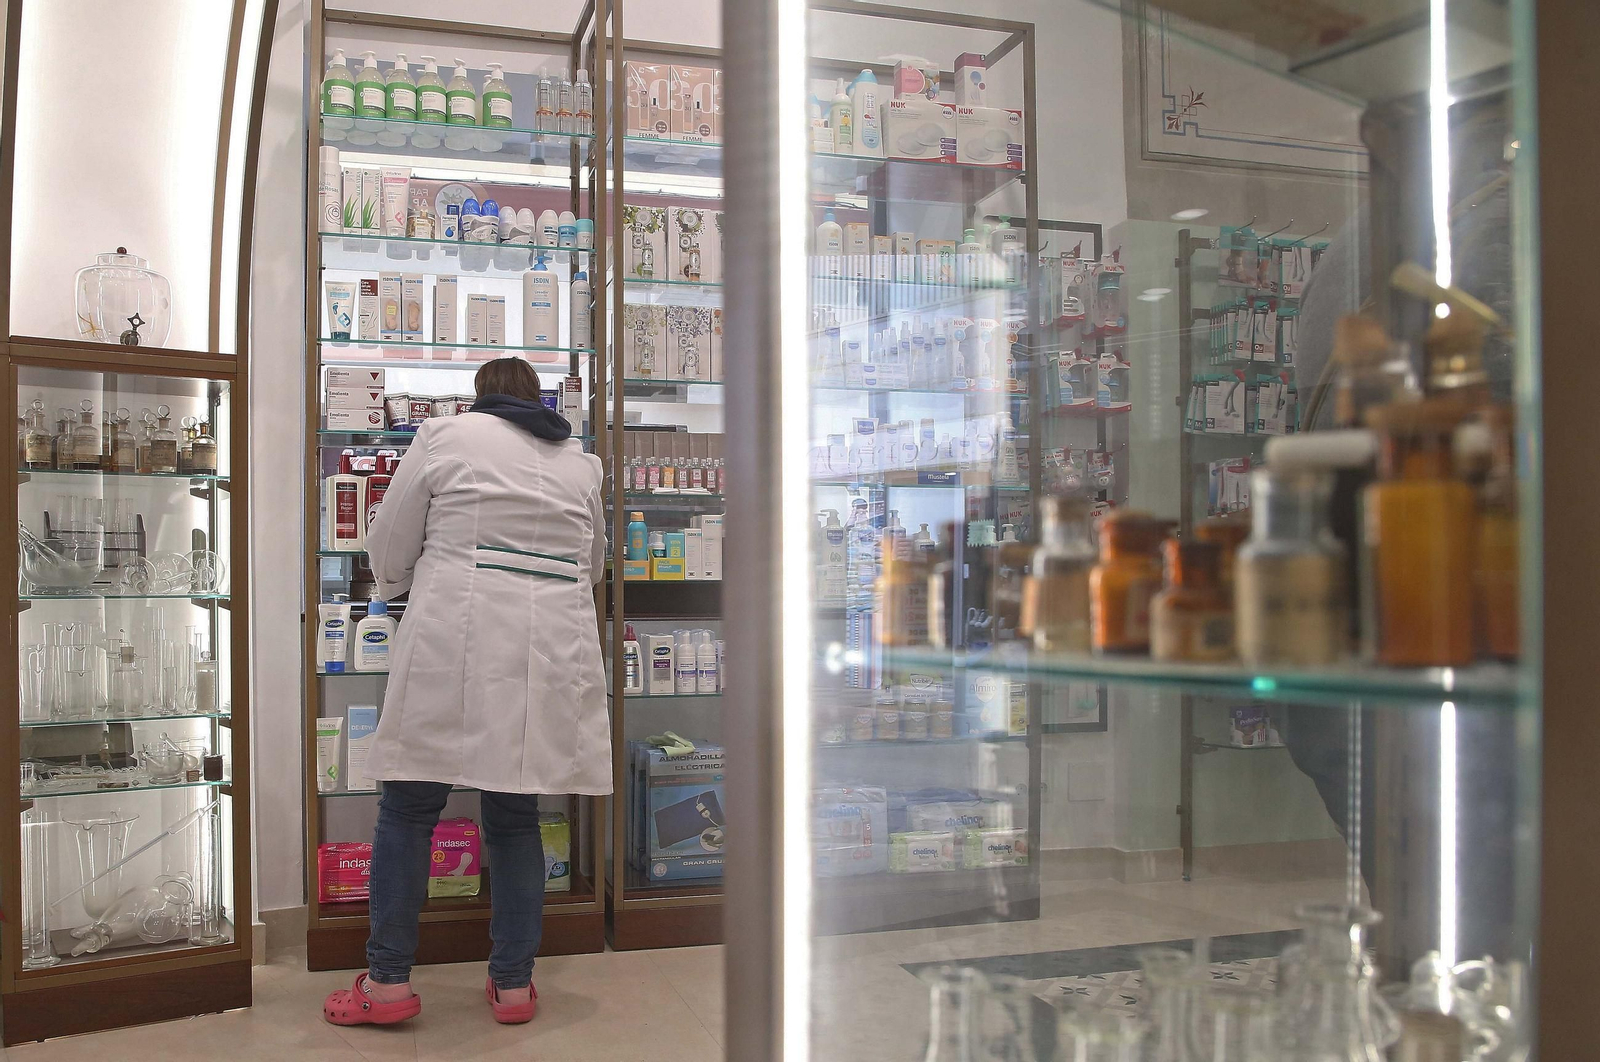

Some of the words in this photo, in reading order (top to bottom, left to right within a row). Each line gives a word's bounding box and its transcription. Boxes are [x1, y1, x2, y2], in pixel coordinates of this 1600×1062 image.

[890, 101, 906, 109] NUK
[1010, 510, 1022, 518] NUK
[659, 753, 725, 763] ALMOHADILLA
[437, 839, 471, 848] indasec
[912, 847, 936, 855] chelino
[433, 852, 444, 861] 22
